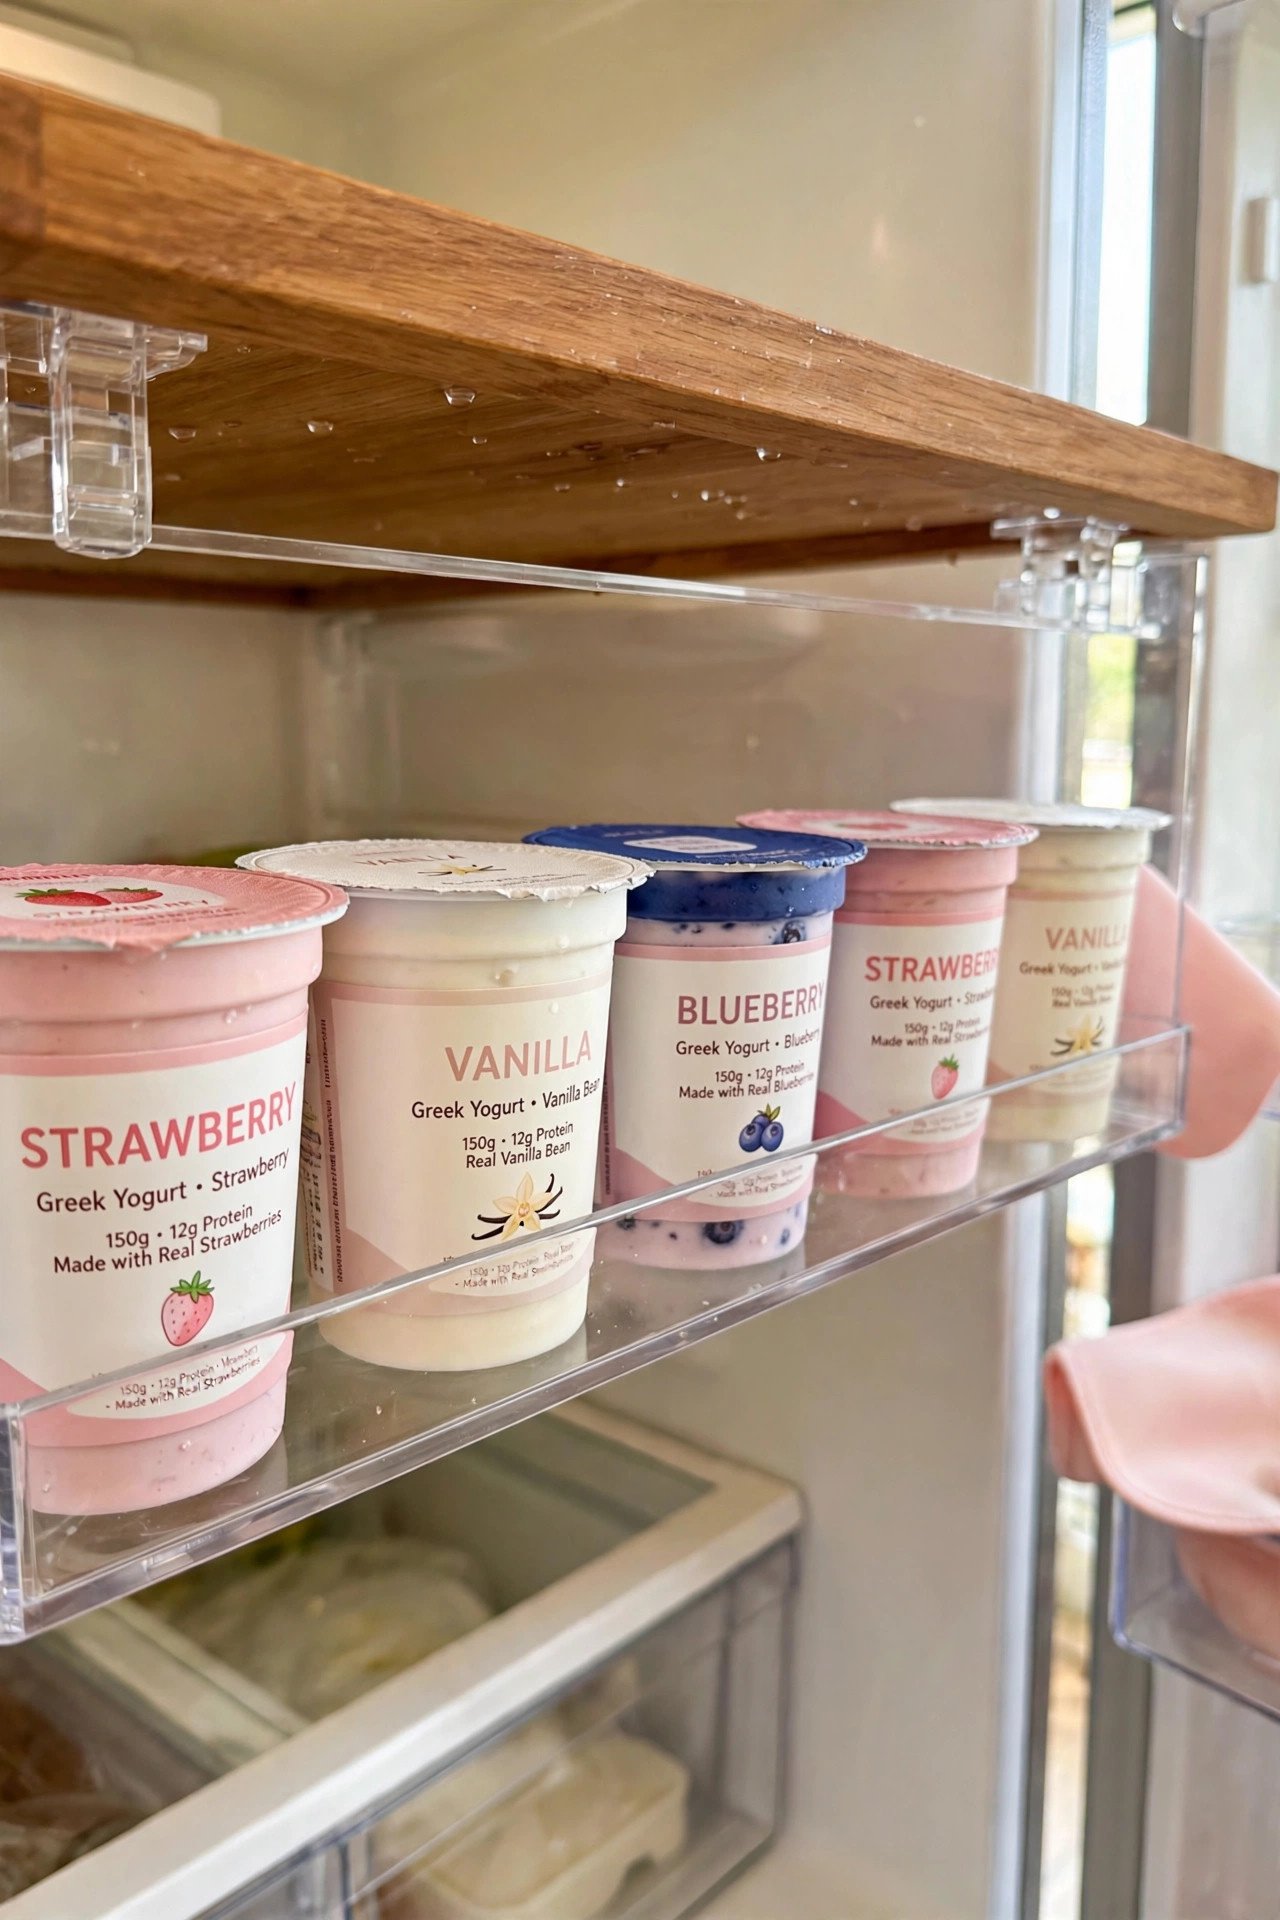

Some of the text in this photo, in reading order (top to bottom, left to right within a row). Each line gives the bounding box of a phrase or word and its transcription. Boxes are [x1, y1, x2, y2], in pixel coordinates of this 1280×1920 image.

[678, 980, 825, 1025] BLUEBERRY
[870, 995, 909, 1010] Greek
[914, 996, 952, 1012] Yogurt
[871, 1034, 903, 1047] Made
[906, 1035, 929, 1046] with
[905, 1022, 928, 1035] 150g
[445, 1030, 592, 1082] VANILLA
[676, 1040, 720, 1055] Greek
[725, 1039, 770, 1058] Yogurt
[679, 1085, 715, 1099] Made
[718, 1082, 745, 1098] with
[748, 1078, 771, 1096] Real
[715, 1070, 743, 1084] 150g
[755, 1067, 773, 1080] 12g
[411, 1100, 465, 1119] Greek
[470, 1097, 525, 1120] Yogurt
[542, 1084, 581, 1109] Vanilla
[21, 1081, 296, 1169] STRAWBERRY
[462, 1121, 574, 1152] 150g 12g Protein
[466, 1140, 571, 1168] Real Vanilla Bean
[37, 1148, 290, 1213] Greek Yogurt Strawberry
[54, 1209, 283, 1274] Made with Real Strawberries
[106, 1203, 254, 1251] 150g 12g Protein
[120, 1364, 215, 1397] 150g 12g Protein
[115, 1397, 147, 1411] Made
[150, 1391, 175, 1406] with
[177, 1383, 201, 1399] Real
